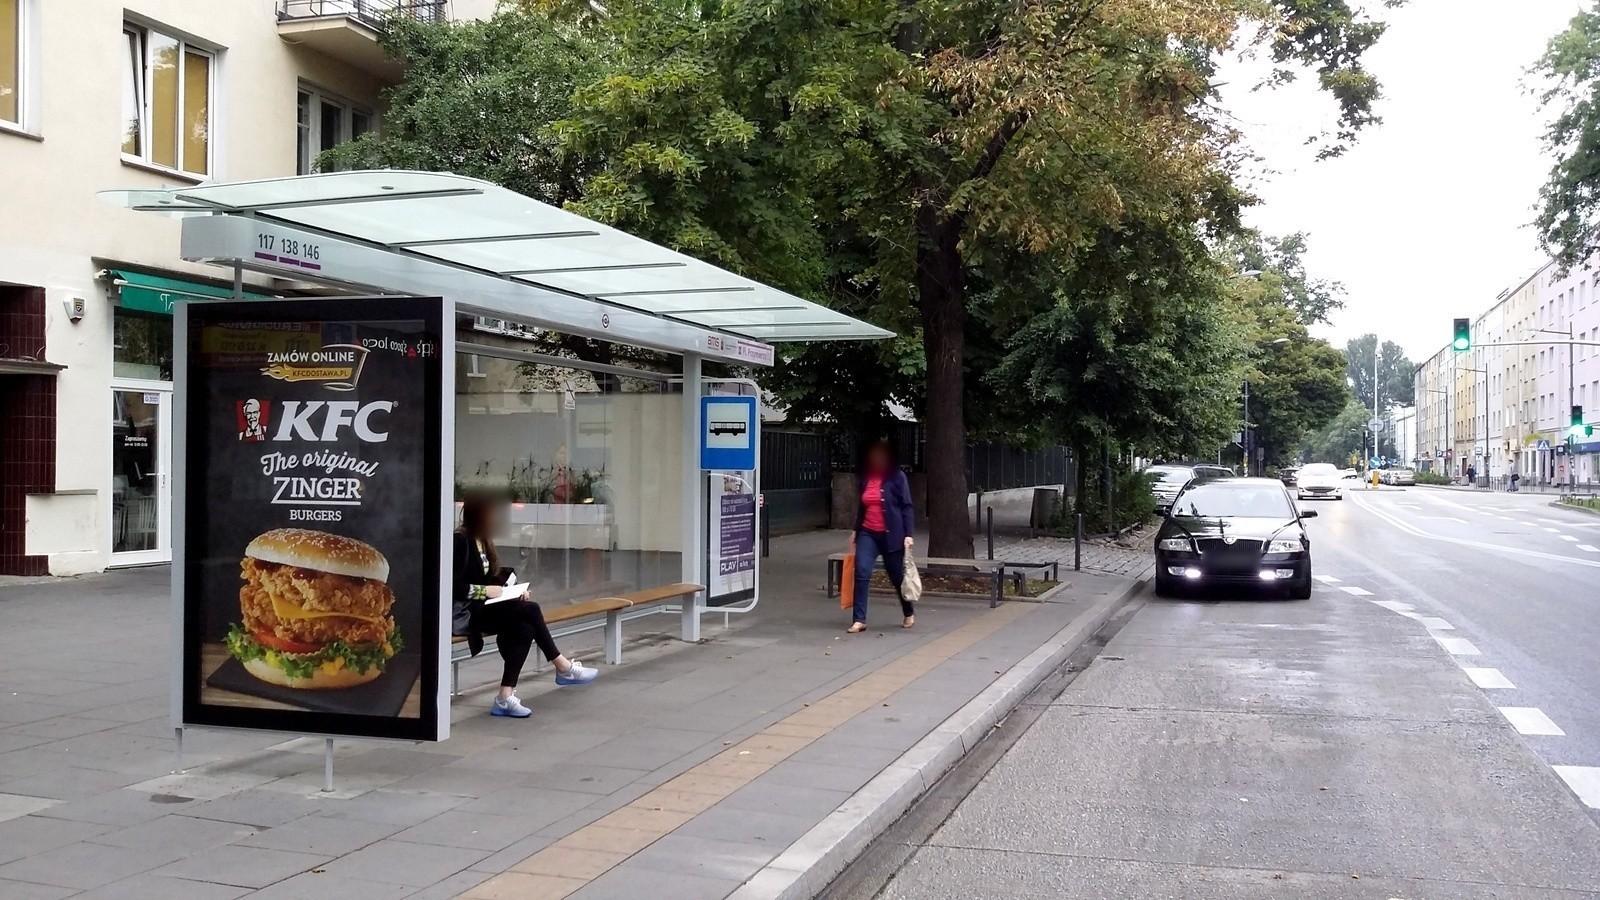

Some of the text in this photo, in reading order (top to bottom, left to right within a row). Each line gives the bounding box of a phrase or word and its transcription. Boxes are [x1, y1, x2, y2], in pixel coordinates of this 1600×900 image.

[258, 233, 320, 260] 117 138 146
[267, 349, 309, 363] ZAMÓW
[311, 351, 354, 362] ONLINE
[292, 369, 348, 377] KFCDOSTAWA.PL
[272, 400, 393, 443] KFC
[260, 449, 379, 477] The original
[270, 476, 361, 505] ZINGER
[289, 509, 342, 521] BURGERS
